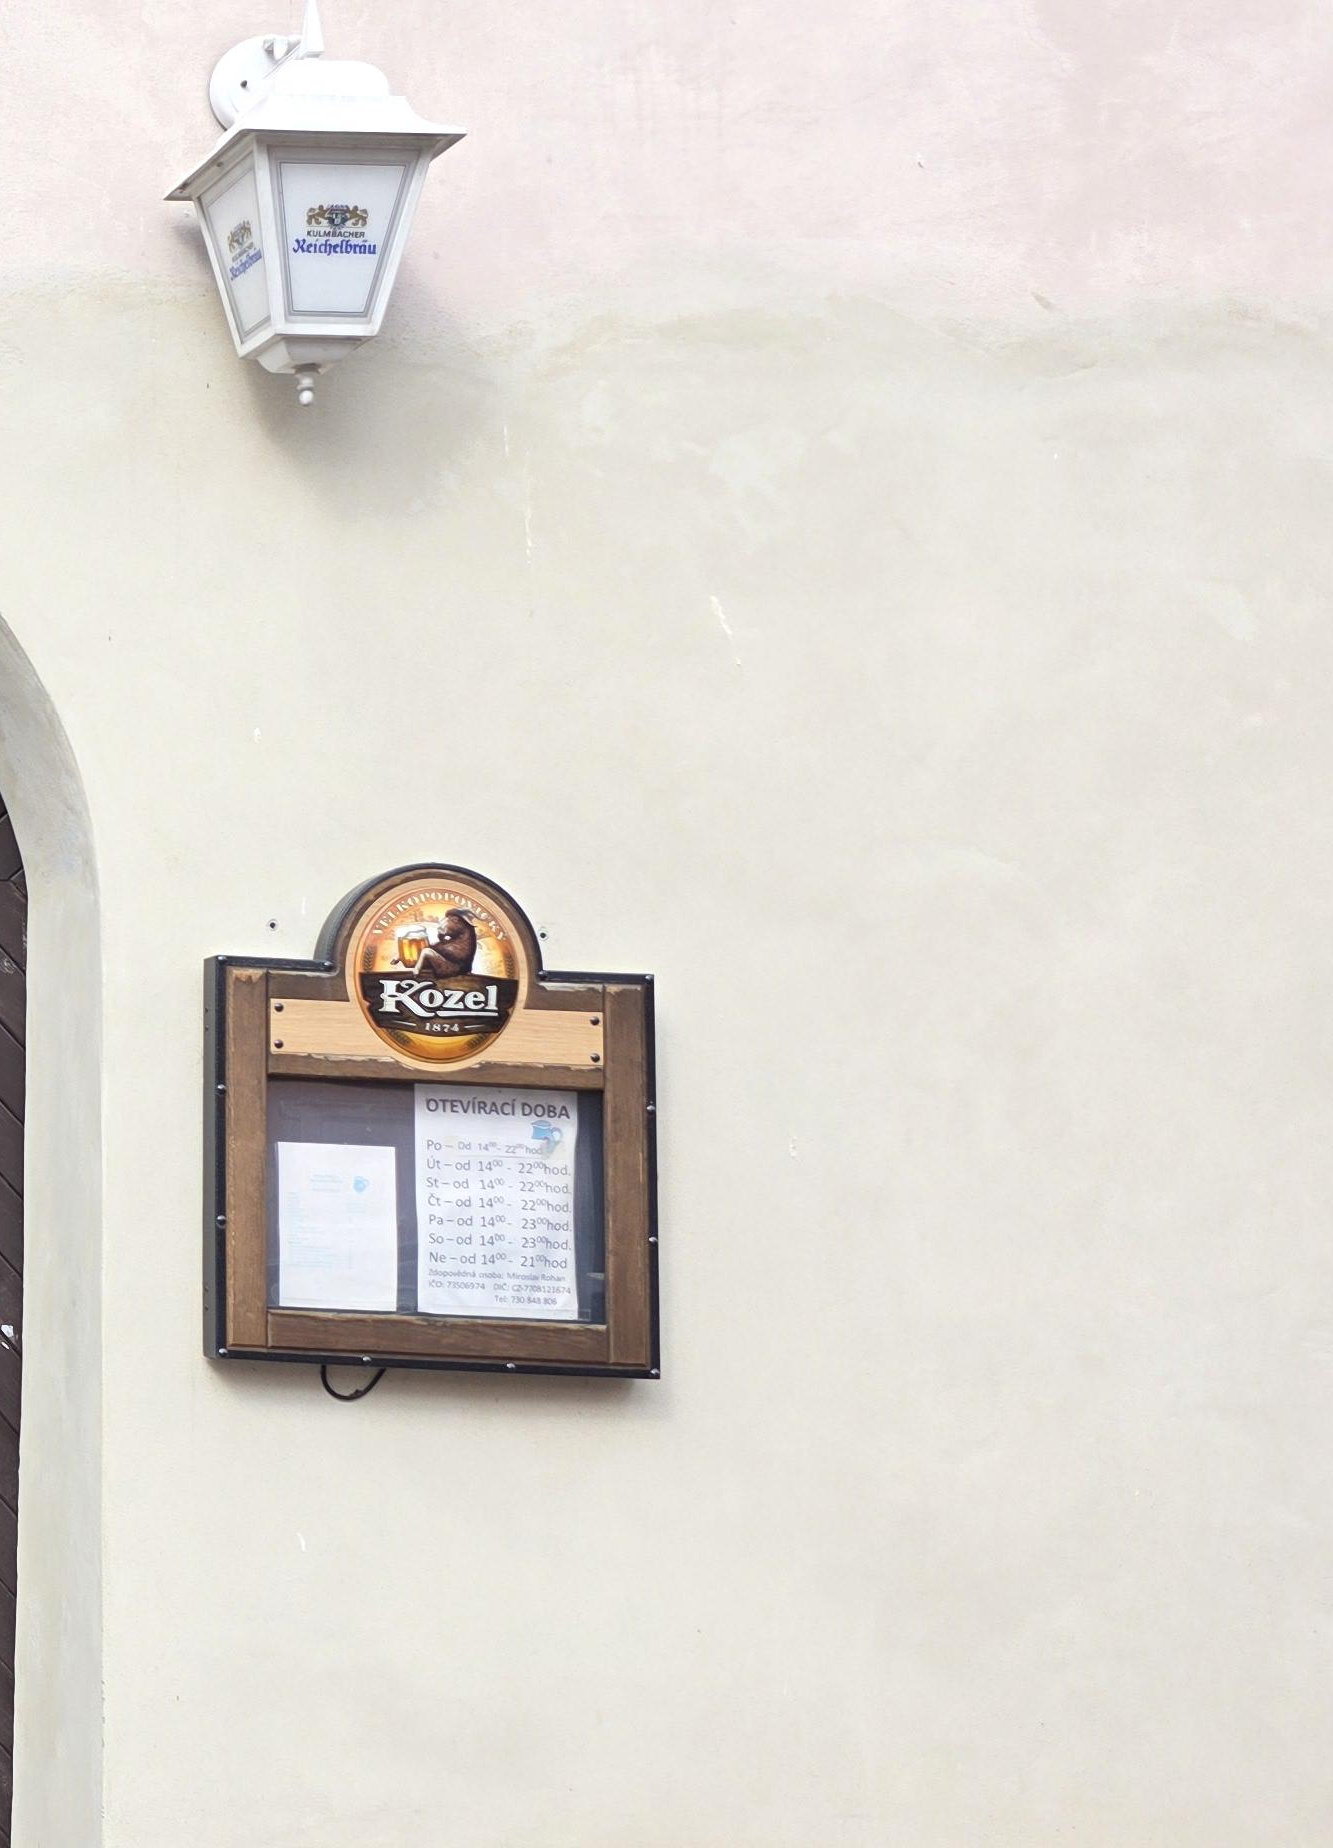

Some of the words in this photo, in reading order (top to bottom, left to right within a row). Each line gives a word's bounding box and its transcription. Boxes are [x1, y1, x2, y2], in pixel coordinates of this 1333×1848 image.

[307, 230, 366, 239] KULMBACHER
[292, 238, 377, 257] Reichelbräu
[378, 979, 499, 1018] Kozel
[424, 1022, 460, 1033] 1874
[425, 1096, 516, 1117] OTEVÍRACÍ
[521, 1101, 571, 1120] DOBA
[426, 1139, 442, 1151] Po
[426, 1154, 441, 1170] Út
[454, 1159, 471, 1171] od
[425, 1177, 439, 1189] St
[452, 1178, 470, 1190] od
[427, 1193, 441, 1207] Čt
[455, 1196, 472, 1208] od
[428, 1214, 444, 1225] Pa
[456, 1215, 473, 1227] od
[428, 1232, 444, 1245] So
[456, 1234, 473, 1246] od
[429, 1251, 447, 1263] Ne
[460, 1253, 476, 1265] od
